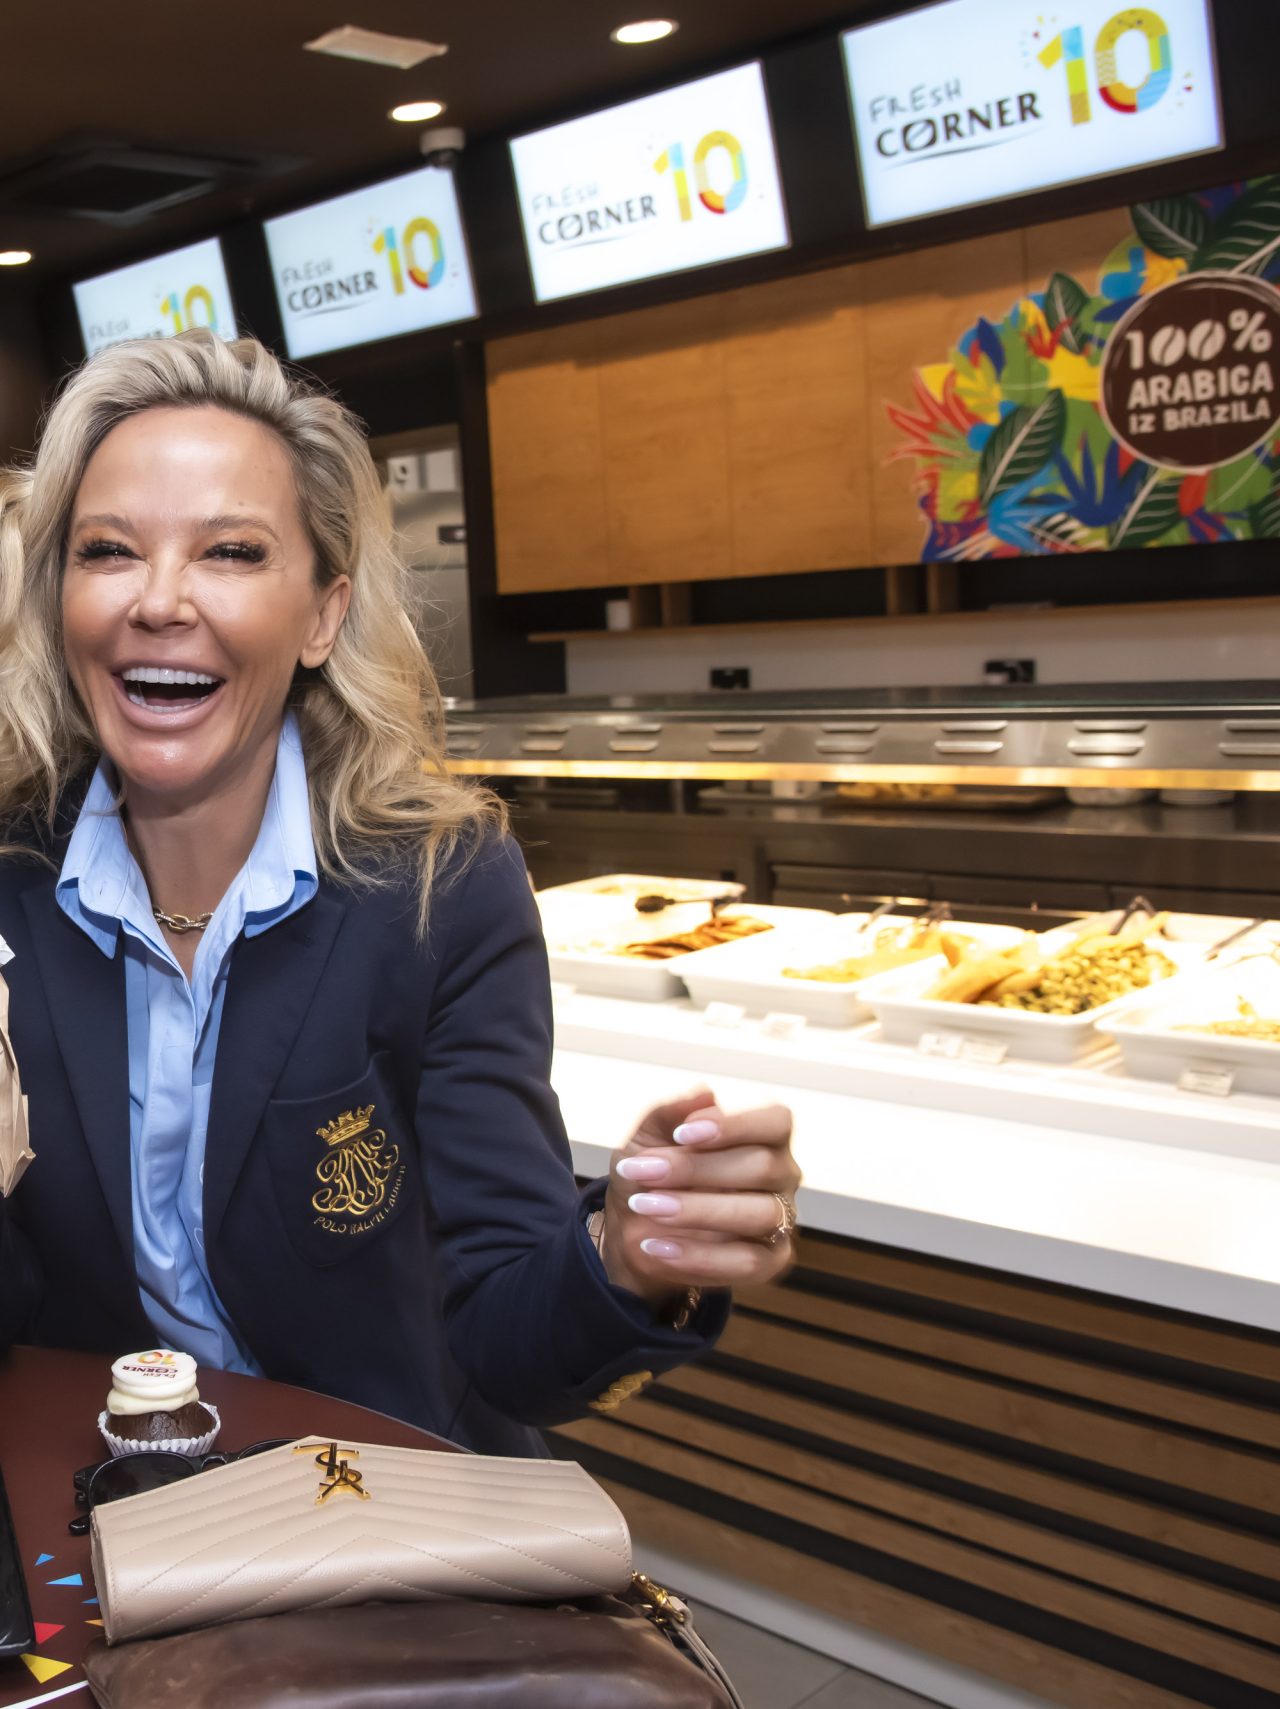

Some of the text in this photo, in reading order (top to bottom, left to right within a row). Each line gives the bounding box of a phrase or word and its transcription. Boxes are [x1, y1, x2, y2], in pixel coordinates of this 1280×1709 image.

[1037, 7, 1172, 126] 10
[870, 78, 962, 123] FRESH
[876, 92, 1042, 157] CORNER
[652, 130, 748, 222] 10
[538, 195, 656, 244] CORNER
[372, 216, 445, 296] 10
[287, 271, 378, 312] CORNER
[1125, 309, 1272, 370] 100%
[1127, 361, 1274, 409] ARABICA
[1129, 397, 1271, 435] IZ BRAZILA
[313, 1216, 347, 1233] POLO
